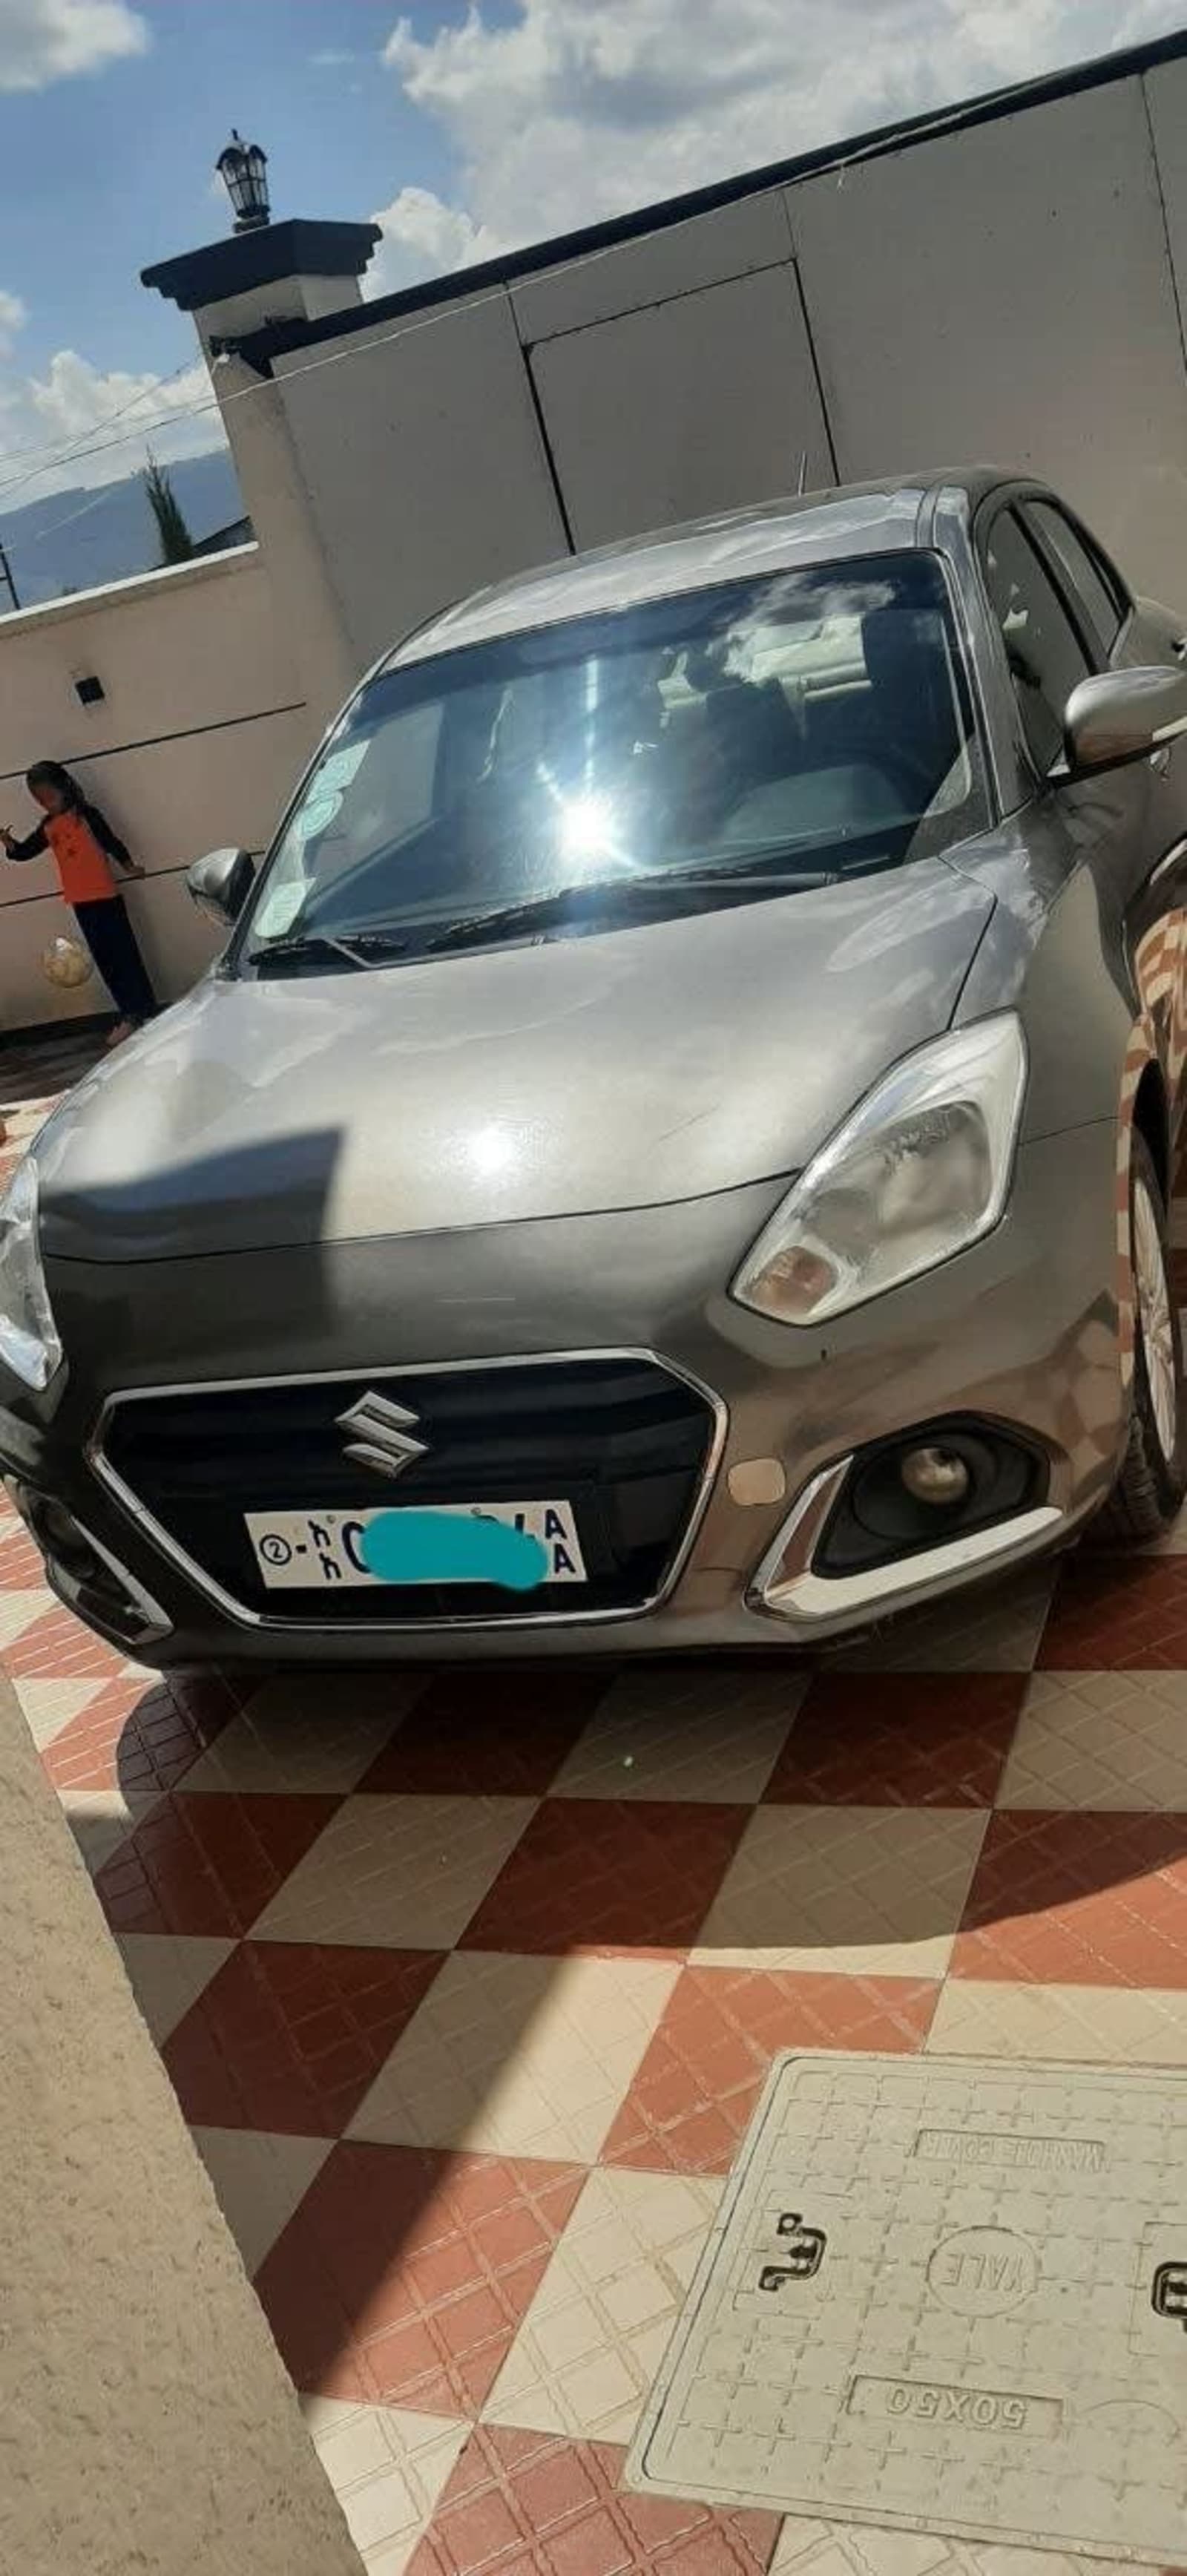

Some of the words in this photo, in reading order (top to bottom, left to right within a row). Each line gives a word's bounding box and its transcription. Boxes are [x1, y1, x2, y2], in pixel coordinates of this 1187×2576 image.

[545, 1509, 568, 1539] A
[554, 1543, 576, 1573] A
[940, 2252, 1027, 2292] YALE
